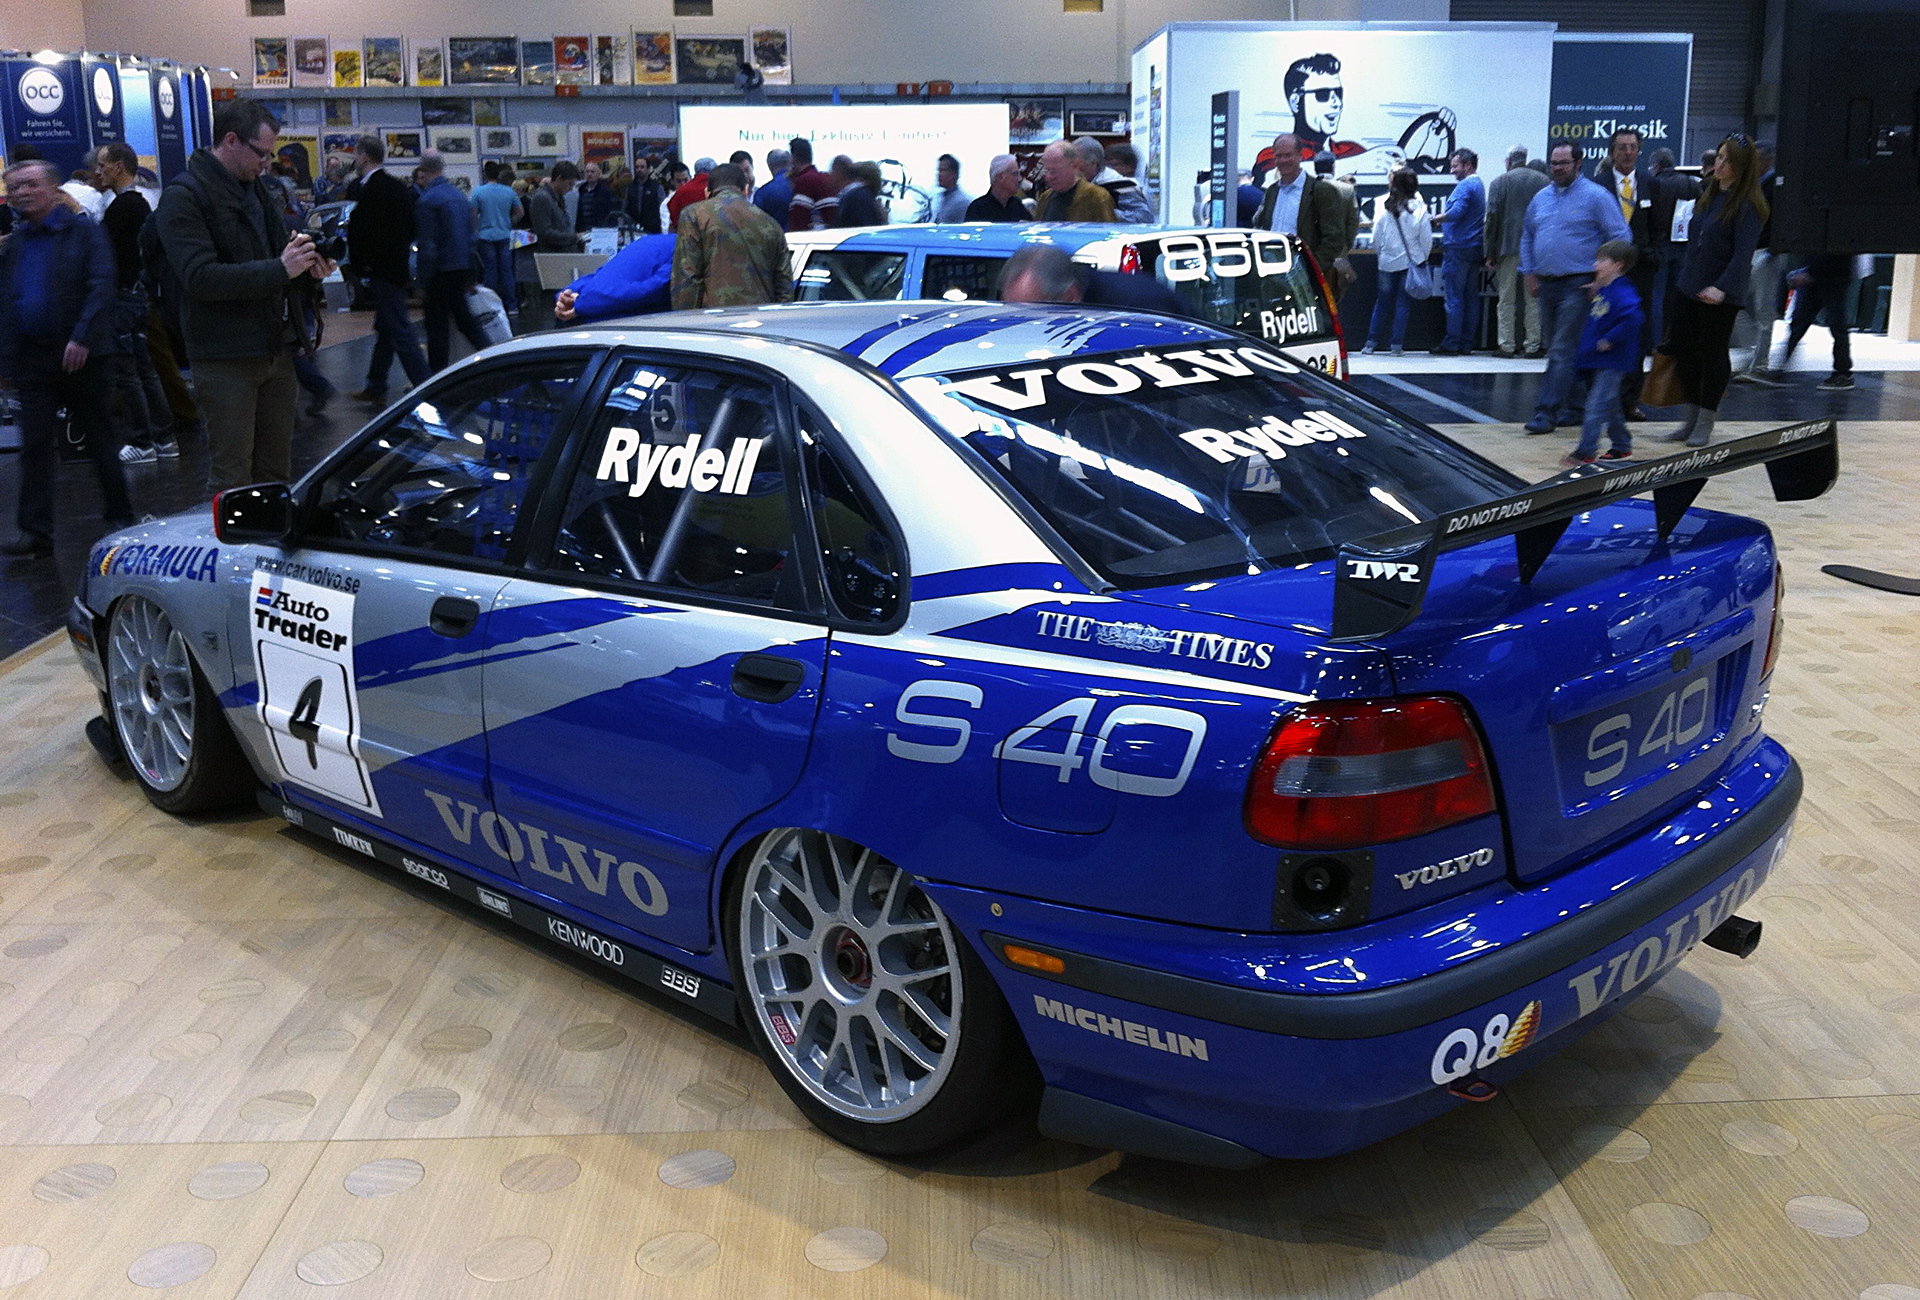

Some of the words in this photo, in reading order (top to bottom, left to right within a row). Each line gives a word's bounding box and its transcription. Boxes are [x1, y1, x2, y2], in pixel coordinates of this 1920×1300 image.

[25, 85, 60, 100] OCC
[1159, 233, 1292, 281] 850
[1260, 306, 1317, 344] Rydell
[940, 346, 1300, 411] VOLVO
[1178, 410, 1367, 464] Rydell
[595, 427, 764, 498] Rydell
[1601, 448, 1731, 495] www.car.volvo.se
[1446, 515, 1469, 534] DO
[1467, 507, 1499, 529] NOT
[1497, 498, 1533, 521] PUSH
[112, 544, 220, 583] FORMULA
[254, 555, 361, 594] www.car.volvo.se
[1346, 559, 1421, 583] TWR
[254, 607, 348, 652] Trader
[270, 590, 330, 622] Auto
[1036, 610, 1095, 643] THE
[1168, 629, 1275, 670] TIMES
[289, 675, 323, 770] 4
[424, 788, 670, 917] VOLVO
[1394, 847, 1494, 890] VOLVO
[547, 916, 625, 966] KENWOOD
[1568, 868, 1756, 1019] VOLVO
[661, 964, 700, 999] BBS
[1033, 994, 1209, 1062] MICHELIN
[1431, 1012, 1509, 1086] Q8
